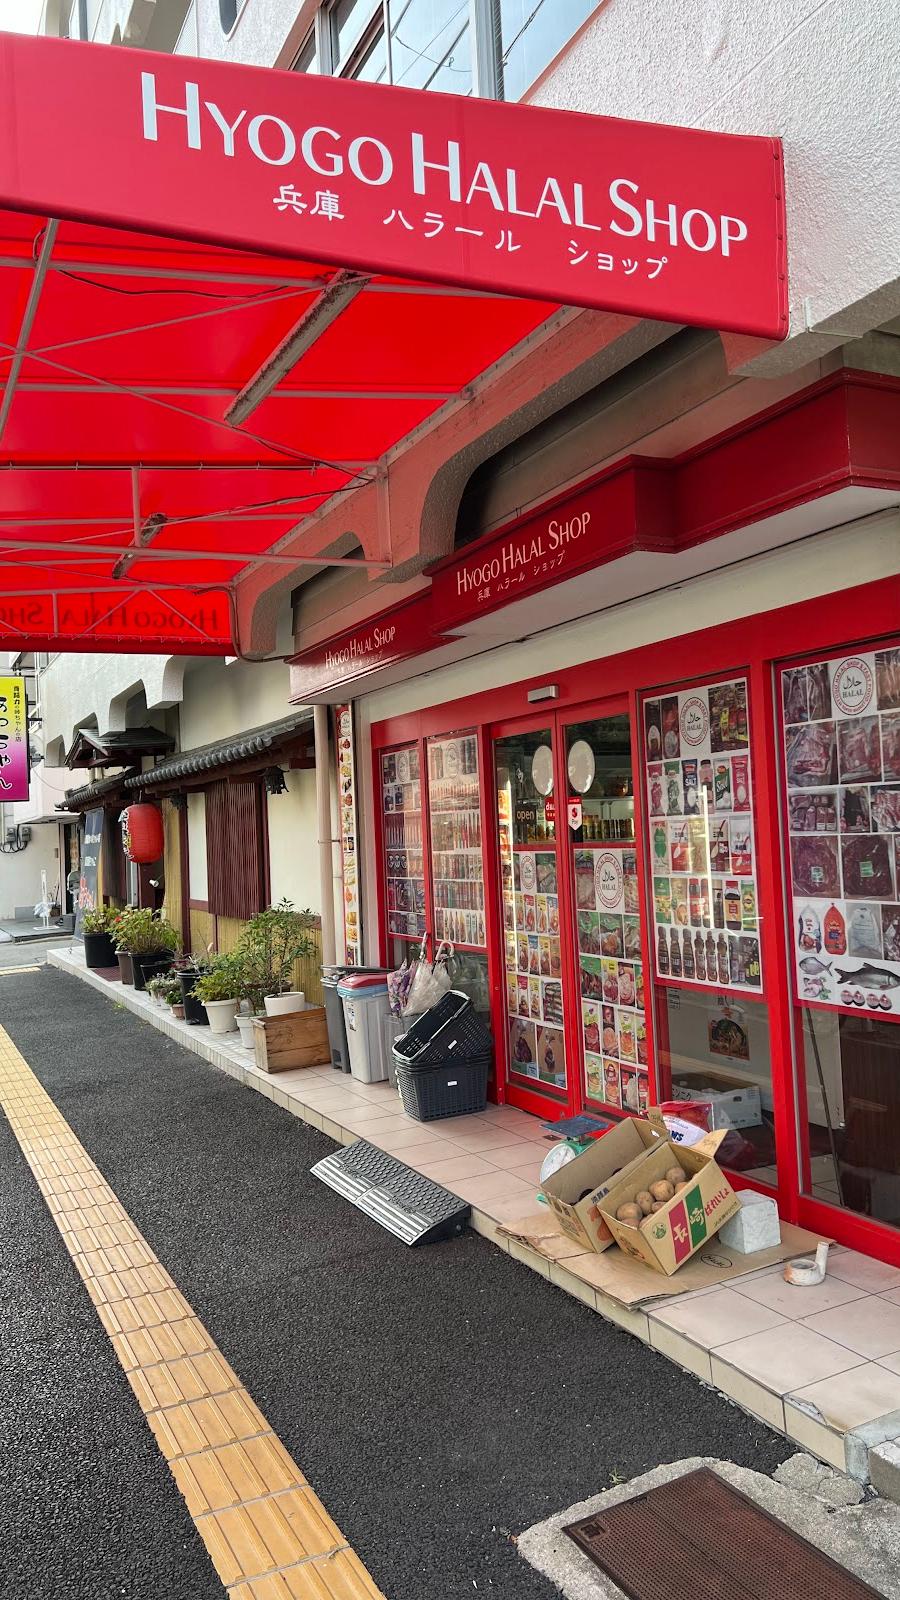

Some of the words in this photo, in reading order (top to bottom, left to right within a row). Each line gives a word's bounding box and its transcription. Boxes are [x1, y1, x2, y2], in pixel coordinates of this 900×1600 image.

[141, 71, 394, 186] HYOGO
[411, 132, 602, 231] HALAL
[609, 178, 748, 257] SHOP
[272, 183, 345, 221] 兵庫
[383, 209, 521, 251] ハラール
[567, 239, 668, 279] ショップ
[457, 559, 500, 596] HYOGO
[502, 536, 546, 573] HALAL
[548, 512, 591, 550] SHOP
[533, 549, 566, 575] ショップ
[325, 647, 350, 670] HYOGO
[350, 636, 373, 659] HALAL
[373, 626, 396, 648] SHOP
[842, 689, 864, 698] HALAL
[516, 810, 535, 821] open
